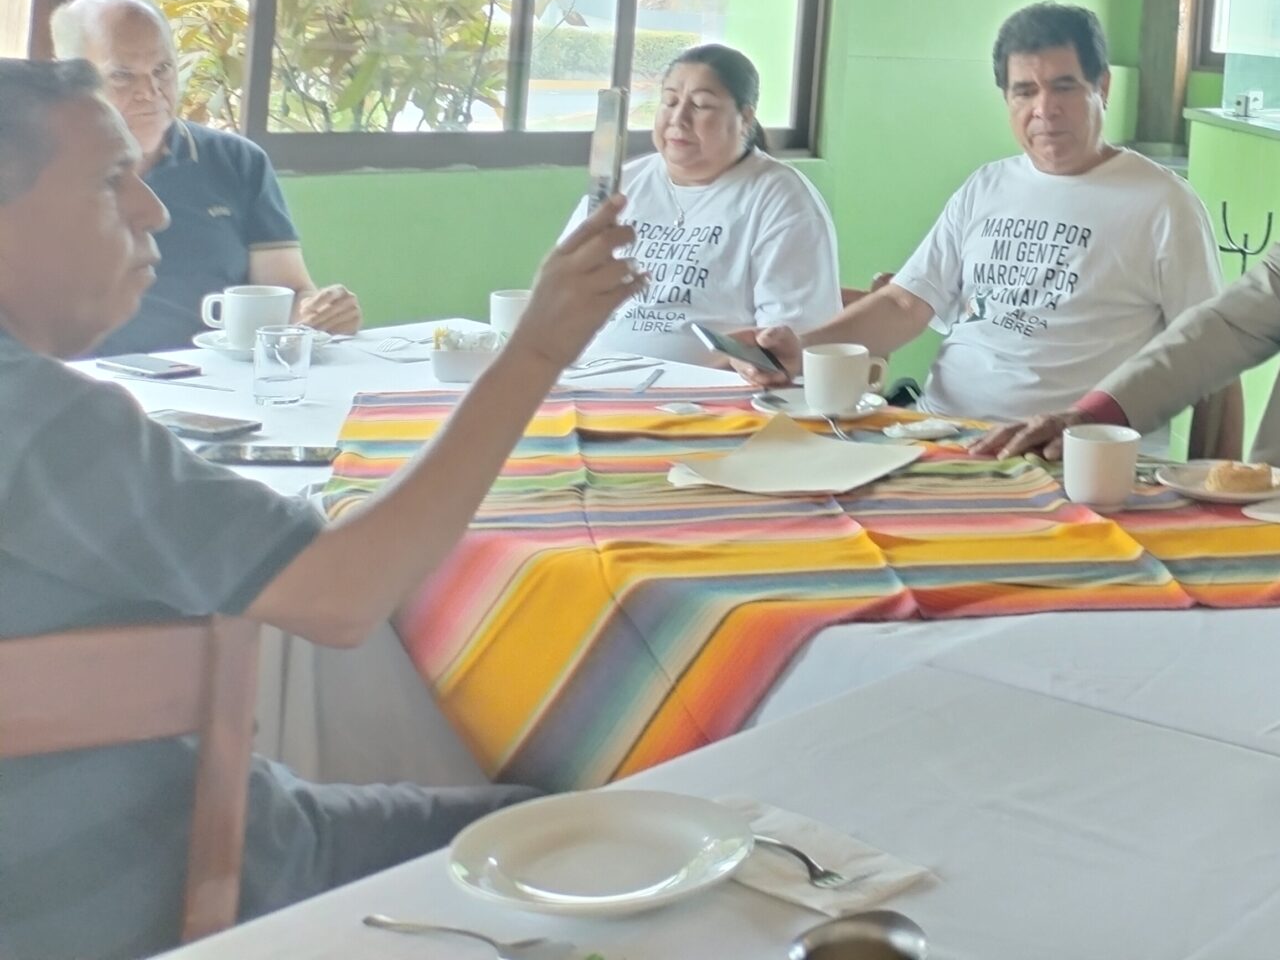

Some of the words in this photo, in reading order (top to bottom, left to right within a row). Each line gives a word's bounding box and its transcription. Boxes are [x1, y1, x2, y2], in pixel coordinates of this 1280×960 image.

[687, 225, 723, 245] POR
[981, 218, 1049, 241] MARCHO
[1053, 222, 1092, 248] POR
[645, 241, 701, 265] GENTE,
[990, 239, 1012, 261] MI
[1016, 241, 1071, 269] GENTE,
[671, 264, 709, 289] POR
[973, 263, 1039, 287] MARCHO
[1042, 267, 1079, 294] POR
[624, 307, 687, 321] SINALOA
[991, 315, 1035, 337] LIBRE
[631, 320, 673, 333] LIBRE
